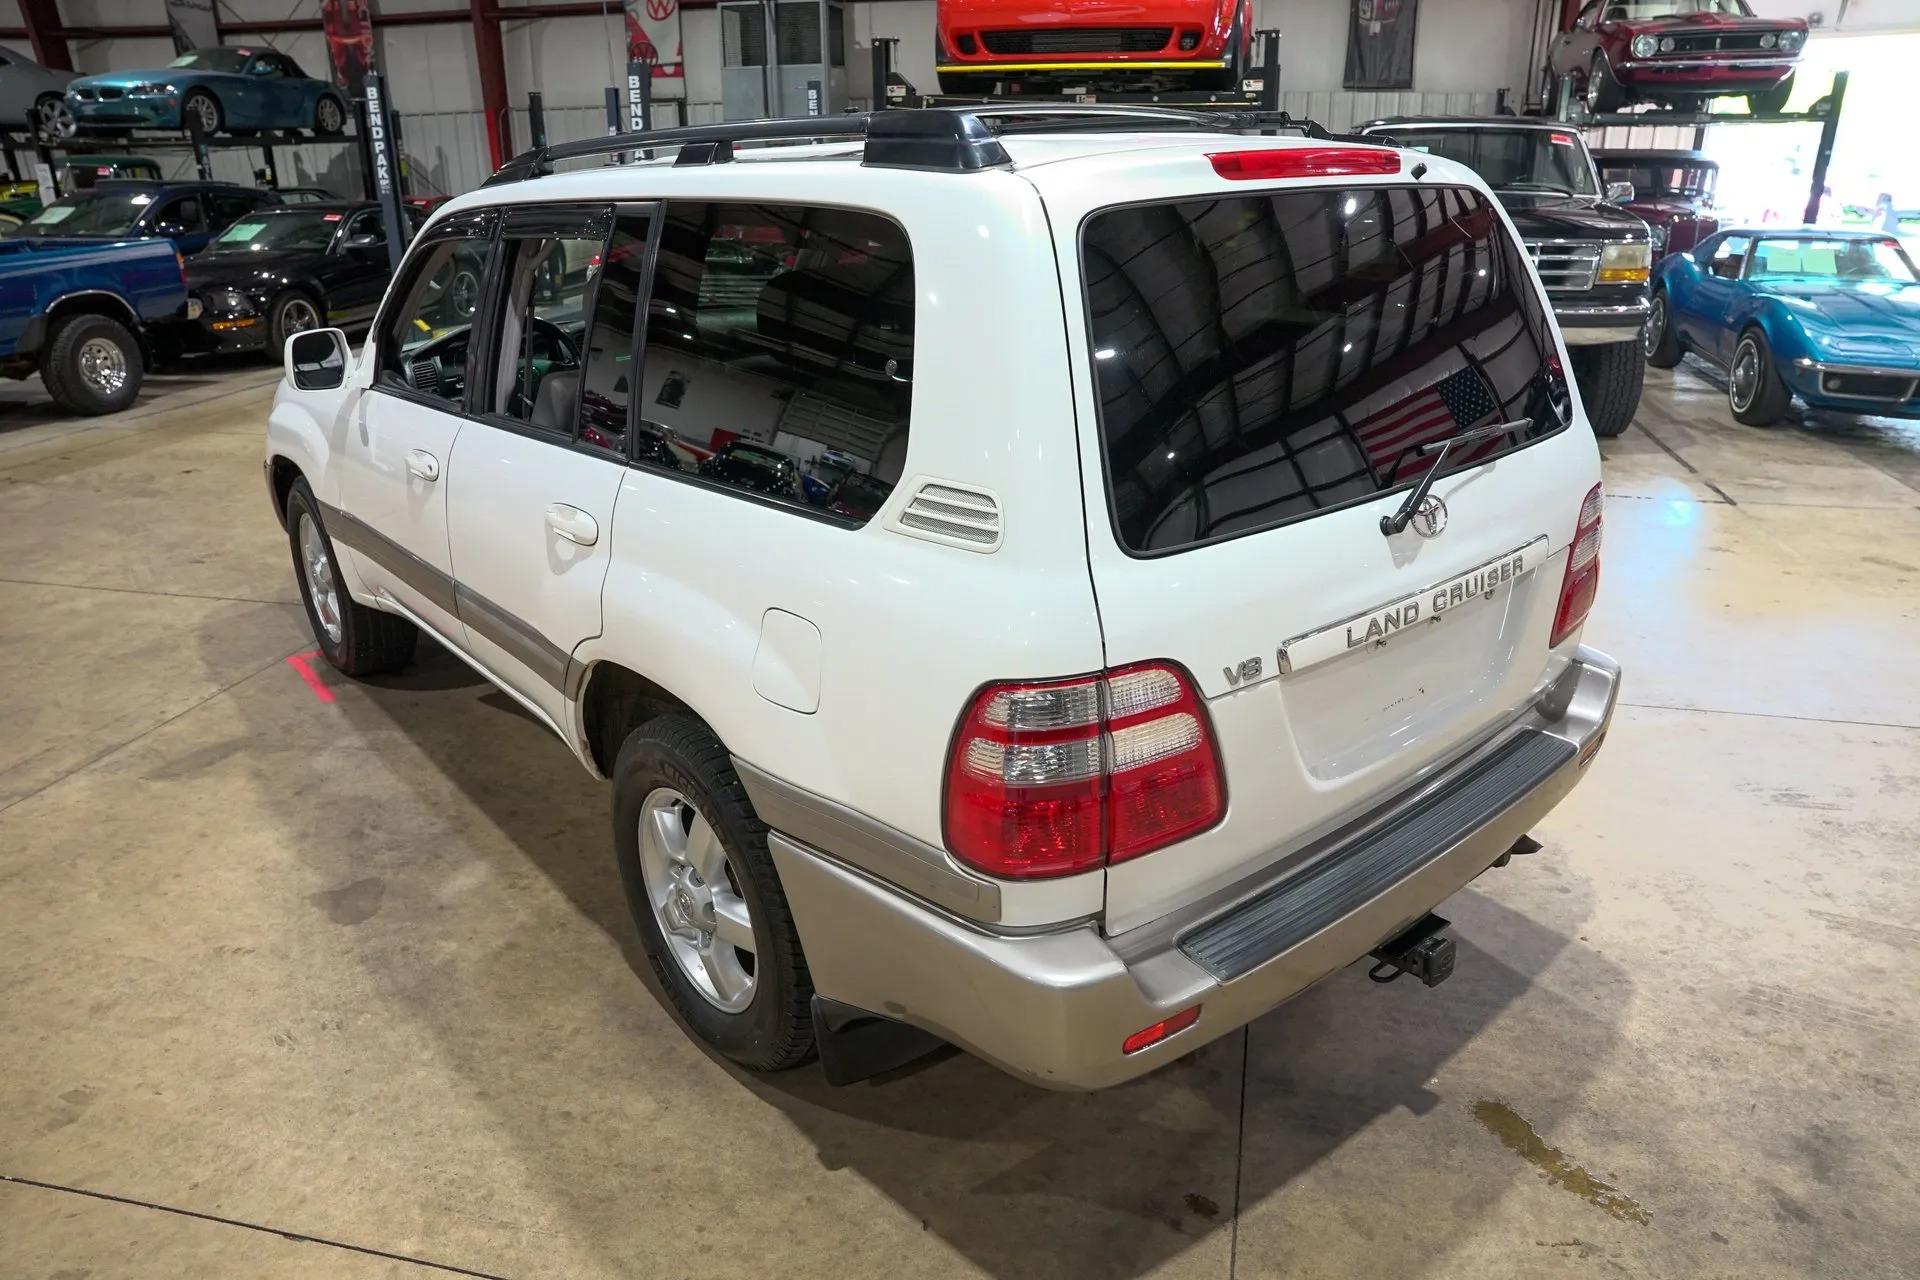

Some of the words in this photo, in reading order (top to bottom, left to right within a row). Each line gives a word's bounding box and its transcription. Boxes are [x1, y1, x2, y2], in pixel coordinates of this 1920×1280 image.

[366, 87, 389, 179] BENDPAK
[1347, 601, 1420, 648] LAND
[1433, 554, 1523, 613] CRUISER
[1223, 656, 1263, 686] V8
